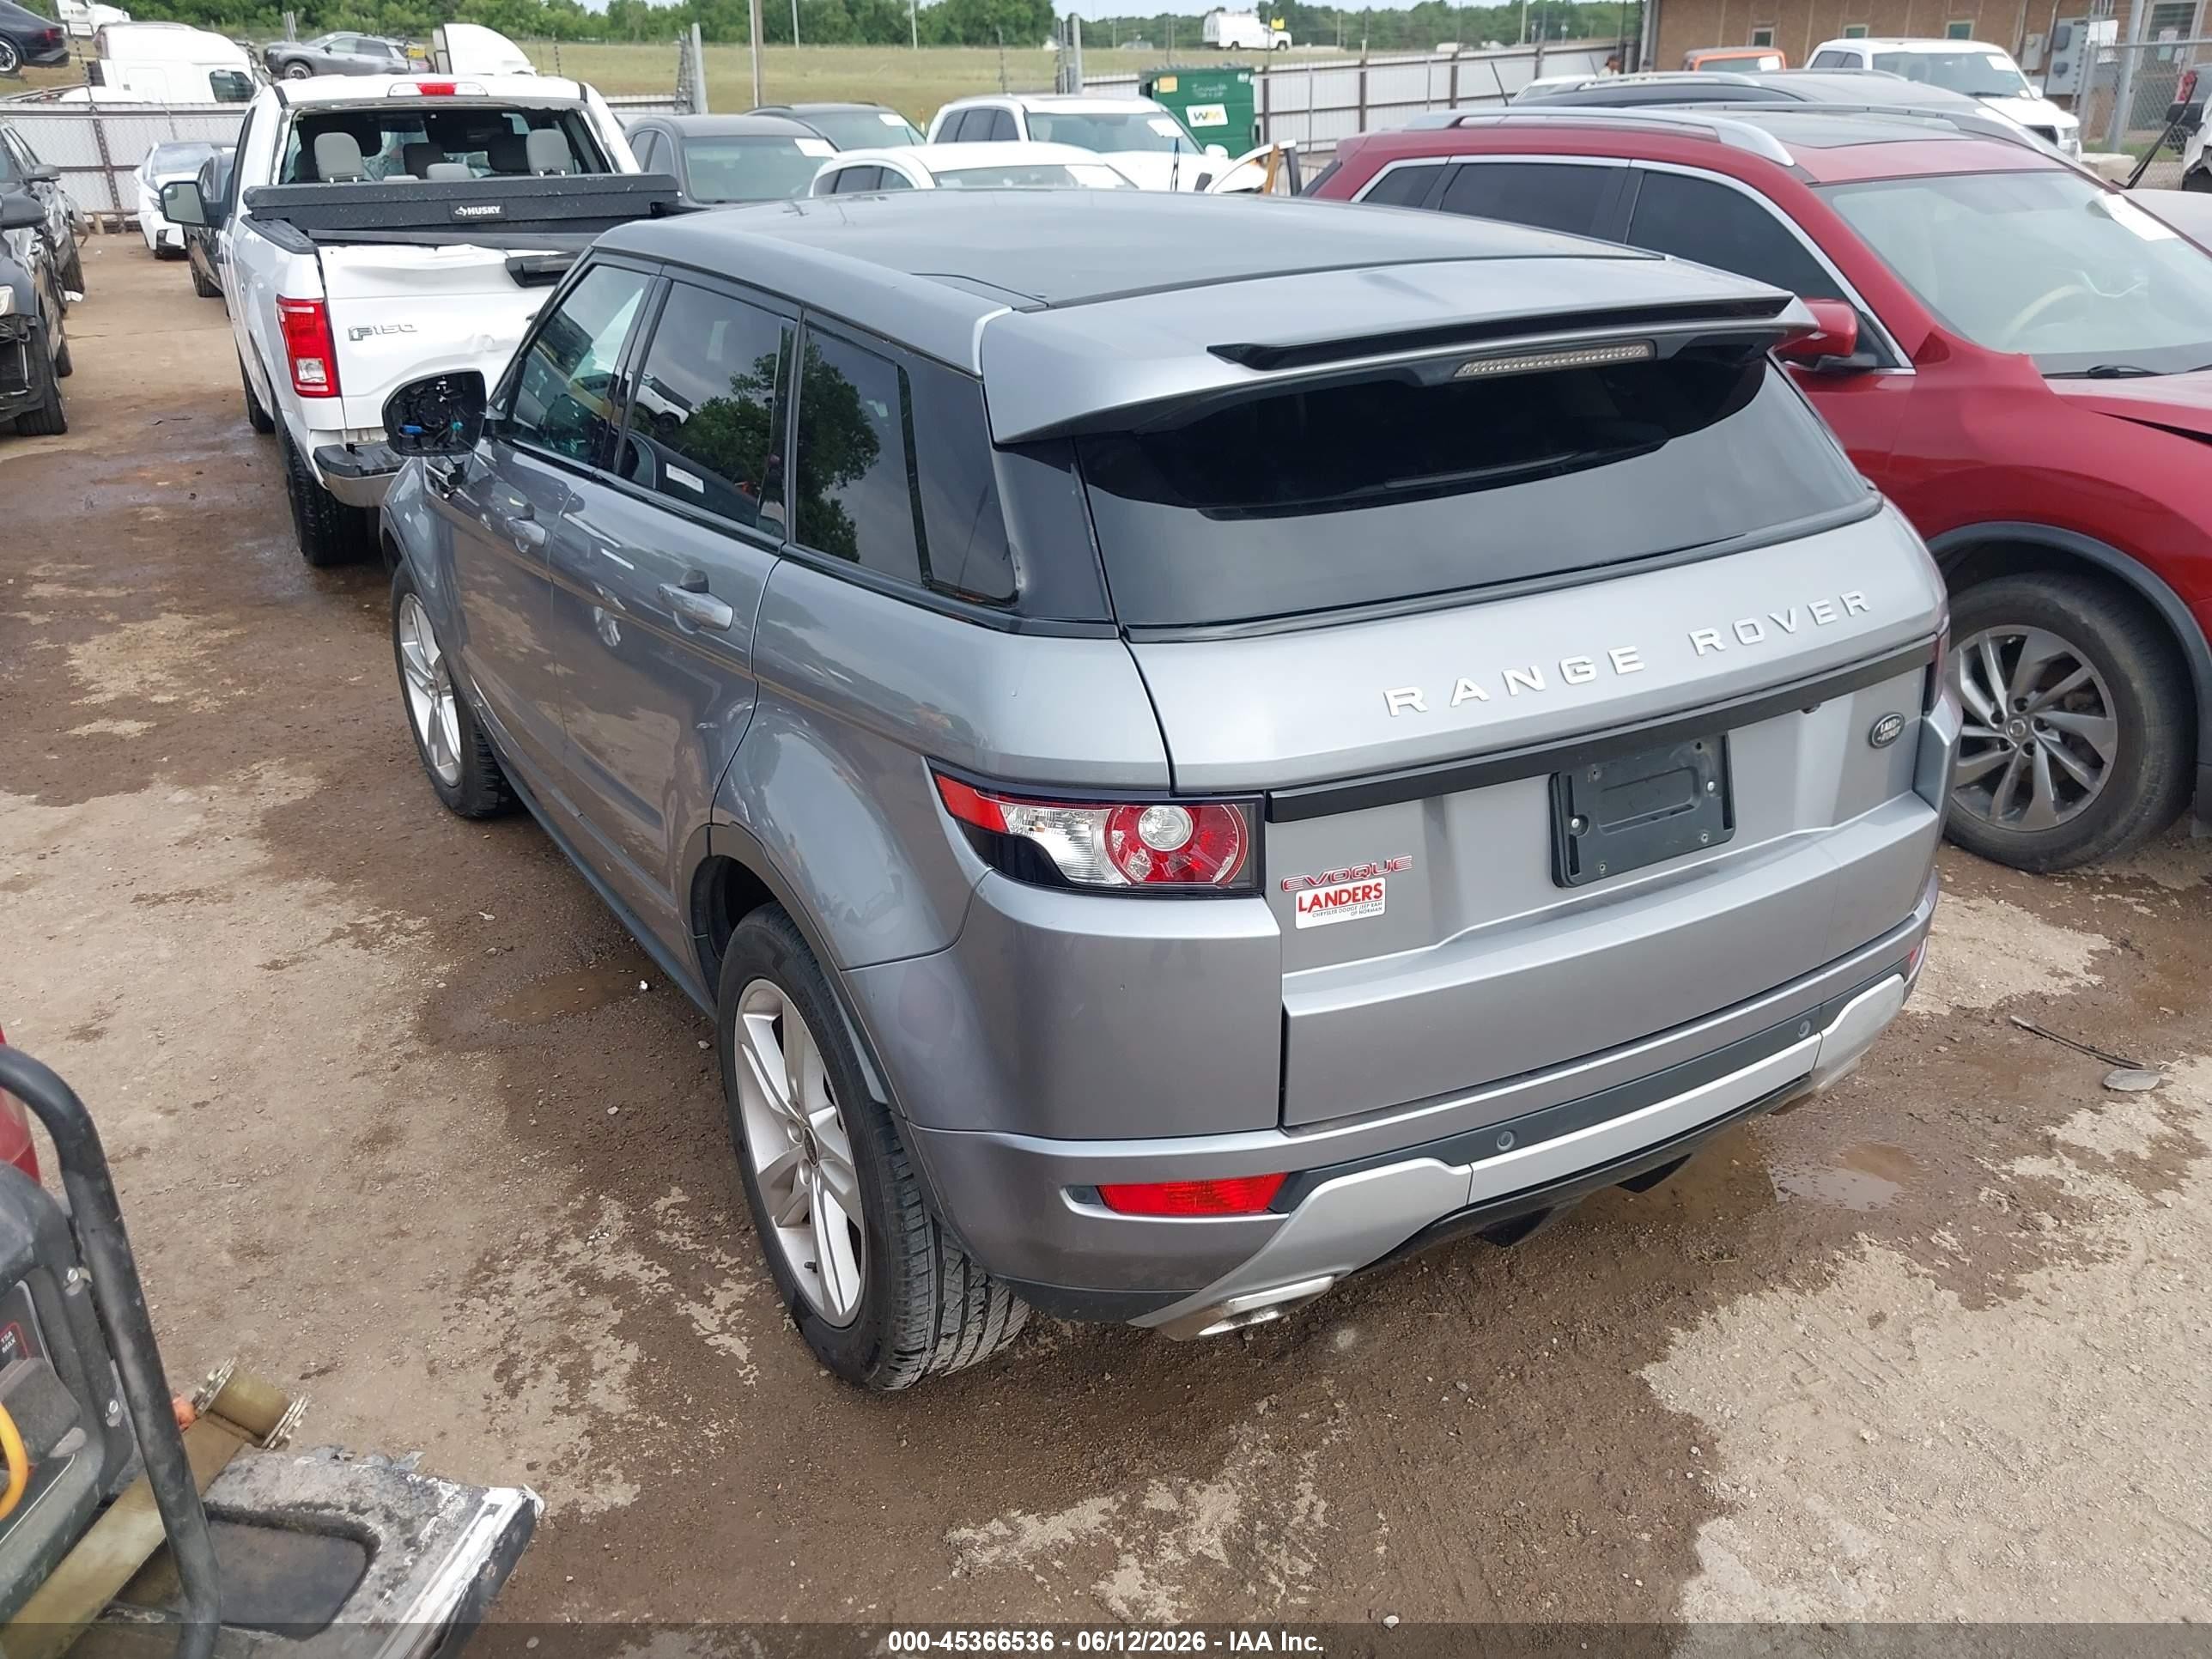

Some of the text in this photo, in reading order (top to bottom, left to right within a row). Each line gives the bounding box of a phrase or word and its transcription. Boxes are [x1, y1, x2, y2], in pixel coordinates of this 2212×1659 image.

[467, 206, 501, 216] HUSKY
[348, 325, 417, 341] F150
[1382, 590, 1870, 717] RANGE ROVER
[1281, 855, 1413, 891] EVOQUE
[1298, 883, 1382, 913] LANDERS
[2, 1337, 16, 1354] MAX
